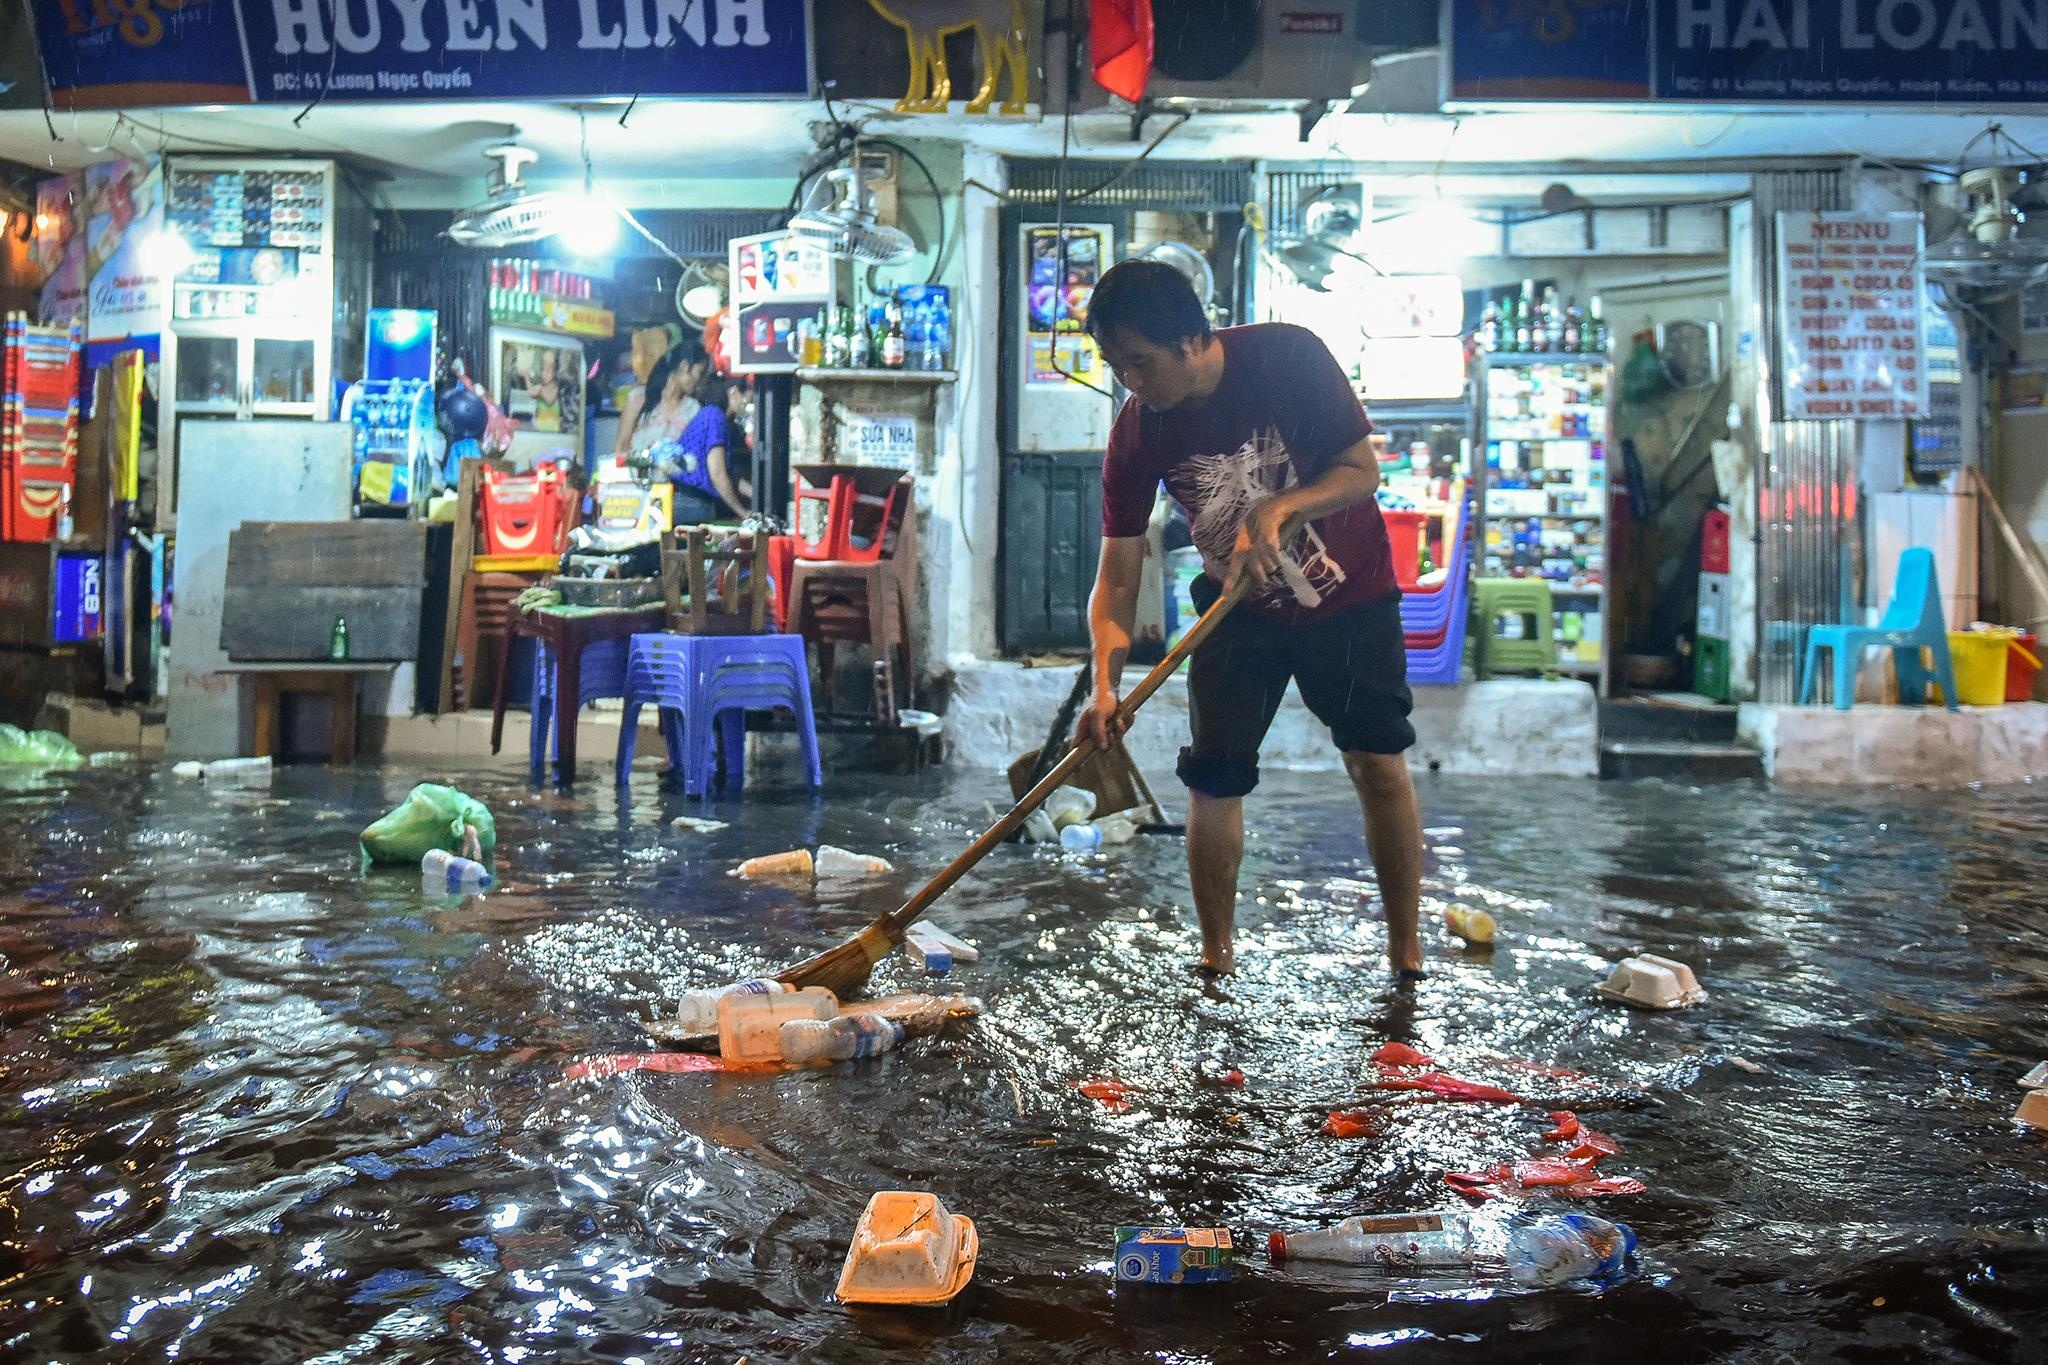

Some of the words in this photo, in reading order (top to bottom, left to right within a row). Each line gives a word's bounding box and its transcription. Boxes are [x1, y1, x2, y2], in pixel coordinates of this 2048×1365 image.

[577, 0, 770, 48] LINH
[1841, 0, 2048, 50] LOAN
[304, 72, 322, 89] 41
[378, 71, 418, 91] Ngọc
[422, 66, 472, 90] Quyến
[1812, 222, 1891, 240] MENU
[1808, 335, 1884, 351] MOJITO
